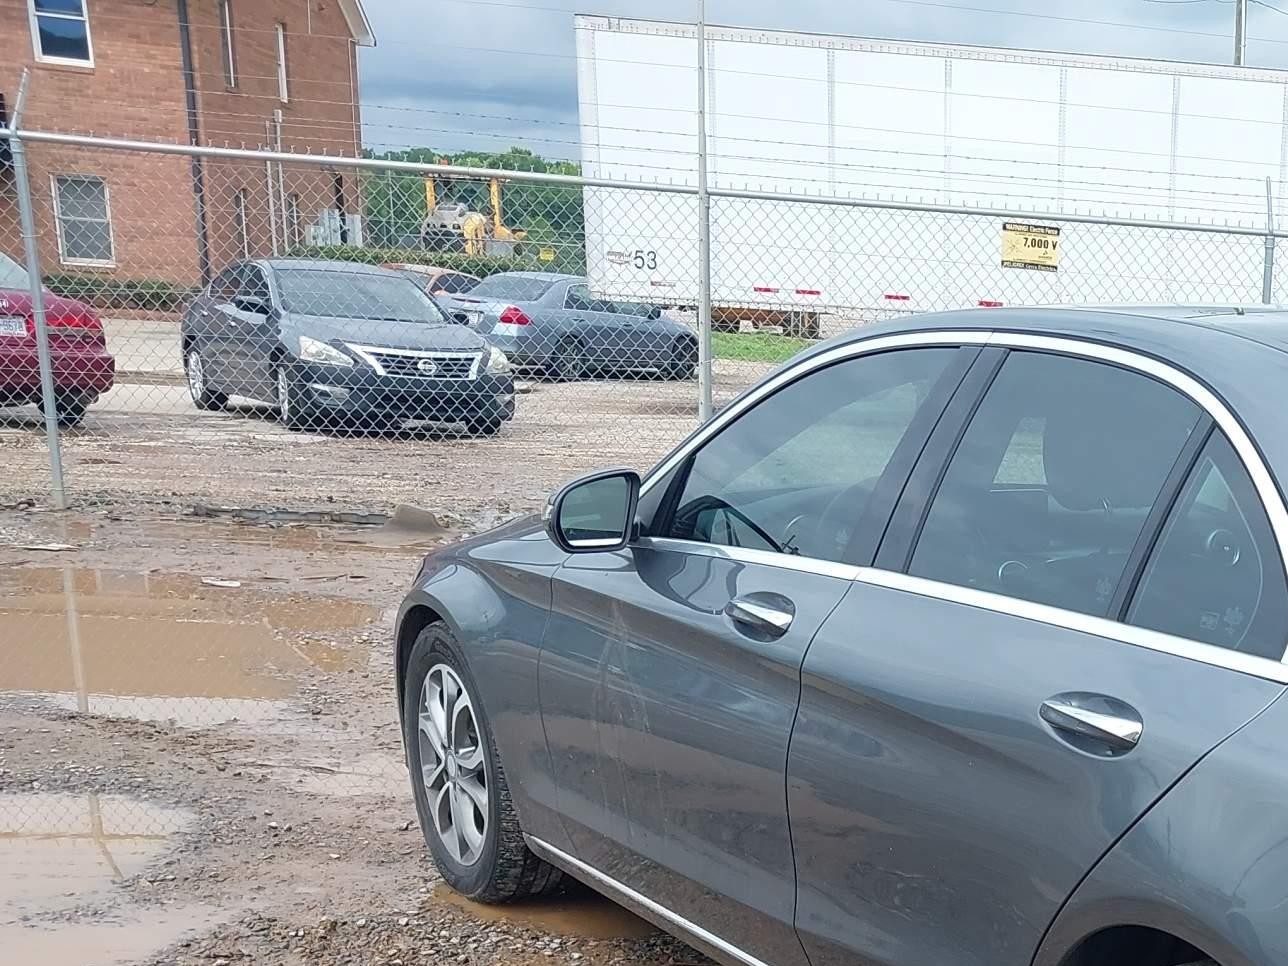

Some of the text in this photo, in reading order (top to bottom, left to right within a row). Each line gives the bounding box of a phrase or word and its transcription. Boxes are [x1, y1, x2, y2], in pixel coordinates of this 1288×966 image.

[1023, 237, 1058, 250] 7,000 V
[633, 250, 657, 270] 53
